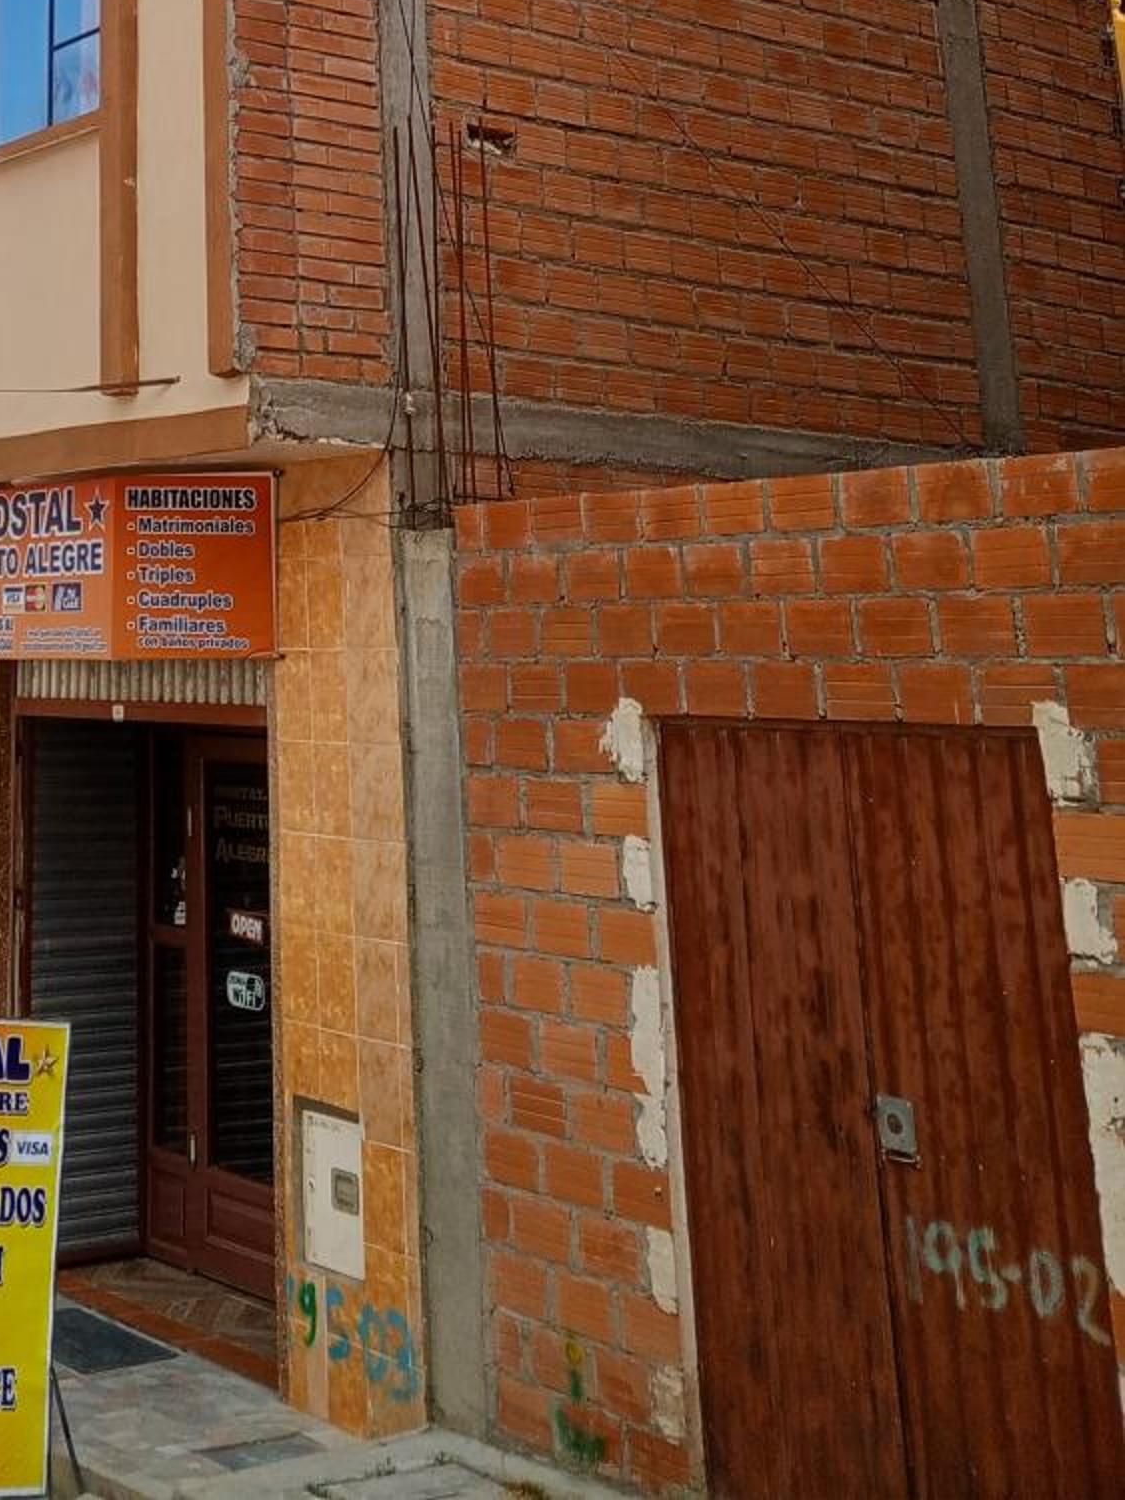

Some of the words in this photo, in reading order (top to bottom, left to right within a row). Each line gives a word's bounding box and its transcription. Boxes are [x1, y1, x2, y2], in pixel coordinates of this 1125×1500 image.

[127, 489, 254, 509] HABITACIONES
[138, 517, 254, 534] Matrimoniales
[138, 541, 194, 557] Dobles
[25, 542, 103, 574] ALEGRE
[138, 567, 194, 585] Triples
[138, 591, 233, 610] Cuadruples
[138, 616, 225, 633] Familiares
[198, 636, 249, 649] privados
[231, 913, 263, 941] OPEN
[16, 1140, 49, 1156] VISA
